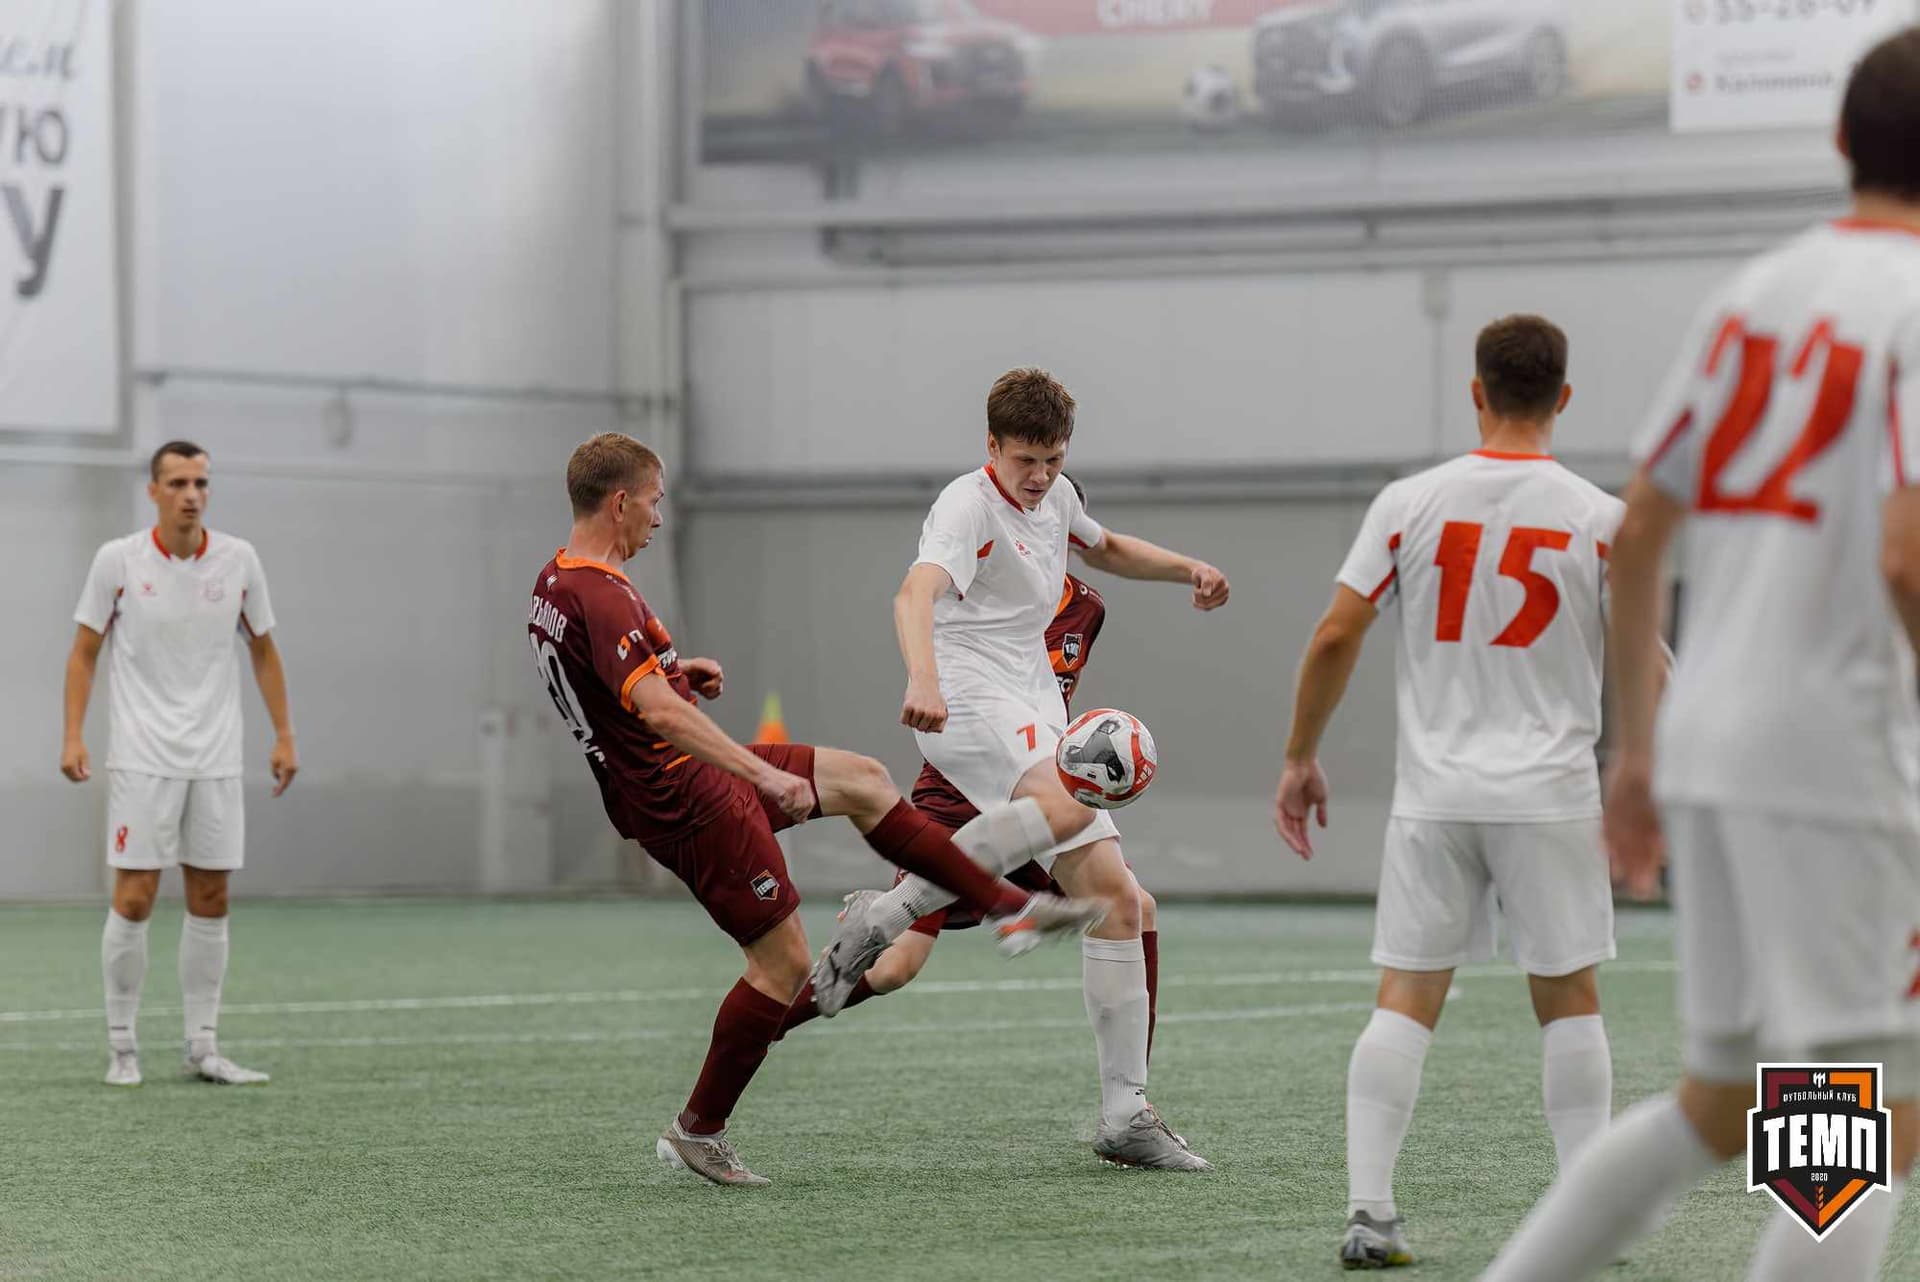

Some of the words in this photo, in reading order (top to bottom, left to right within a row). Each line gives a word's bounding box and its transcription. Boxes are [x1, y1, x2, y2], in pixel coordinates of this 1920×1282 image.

[1695, 314, 1864, 524] 22
[1434, 520, 1573, 648] 15
[114, 825, 129, 853] 8
